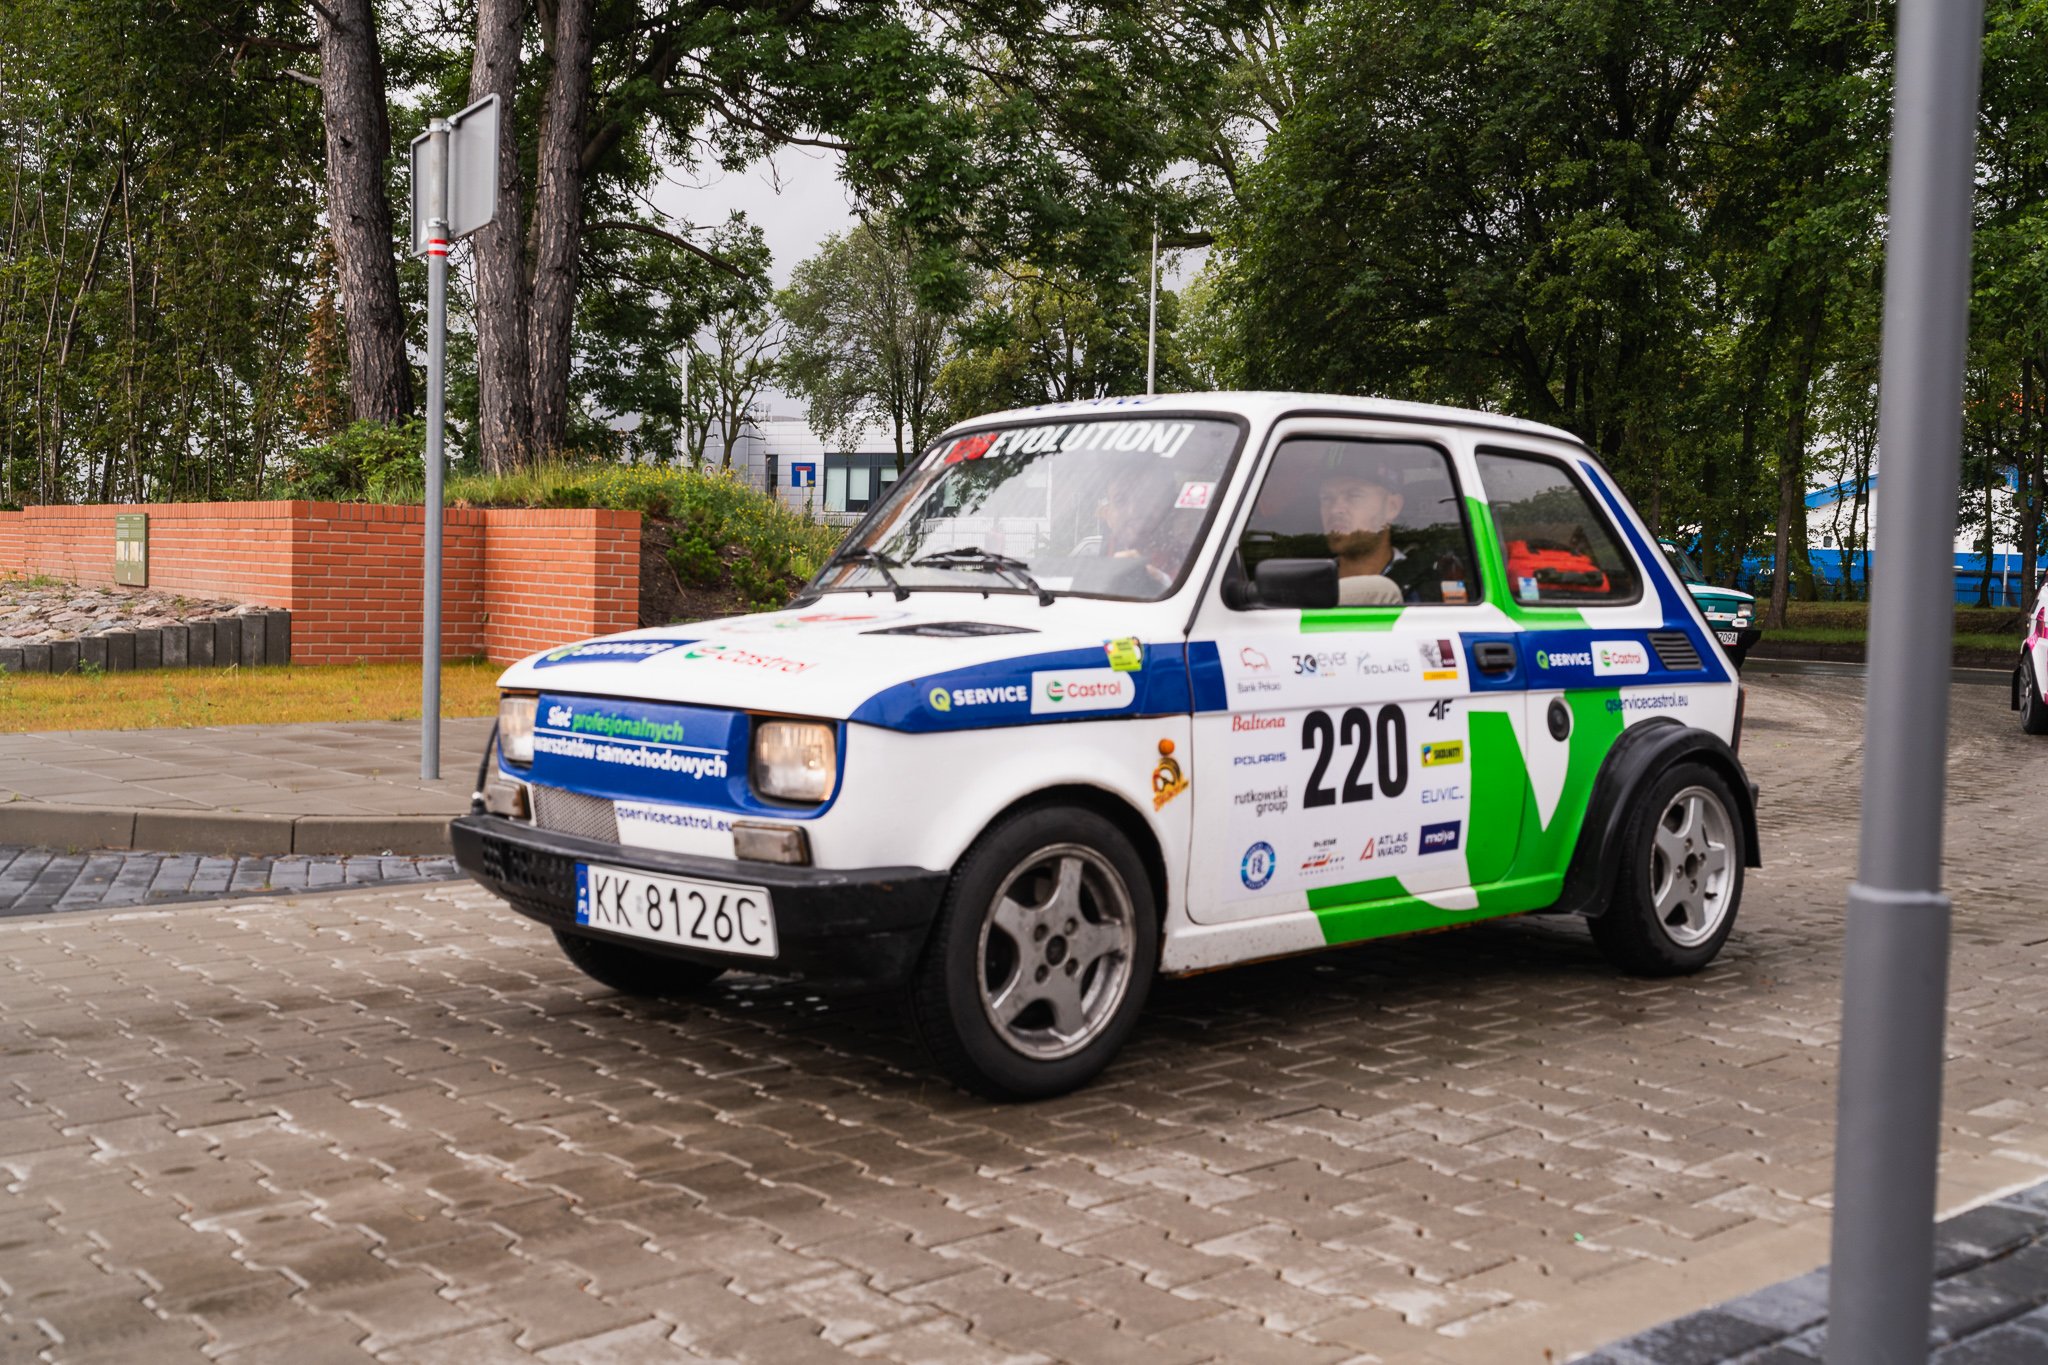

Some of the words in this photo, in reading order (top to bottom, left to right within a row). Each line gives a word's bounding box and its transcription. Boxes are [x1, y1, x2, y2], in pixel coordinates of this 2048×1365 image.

[716, 649, 819, 675] Castrol
[1549, 652, 1592, 667] SERVICE
[1612, 652, 1641, 664] Castrol
[952, 685, 1028, 706] SERVICE
[1067, 681, 1121, 698] Castrol
[1238, 682, 1256, 694] Bank
[1258, 681, 1282, 693] Pekao
[1605, 692, 1688, 715] qservicecastrol.eu
[547, 705, 573, 728] Sieć
[572, 711, 685, 743] profesjonalnych
[1232, 714, 1286, 732] Baltona
[533, 735, 597, 760] warsztatów
[595, 746, 728, 779] samochodowych
[1234, 752, 1287, 766] POLARIS
[1301, 703, 1409, 810] 220
[1234, 785, 1288, 806] rutkowski
[1256, 800, 1288, 817] group
[1378, 832, 1408, 845] ATLAS
[1377, 844, 1408, 858] WARD
[595, 873, 632, 928] KK
[646, 884, 762, 945] 8126C
